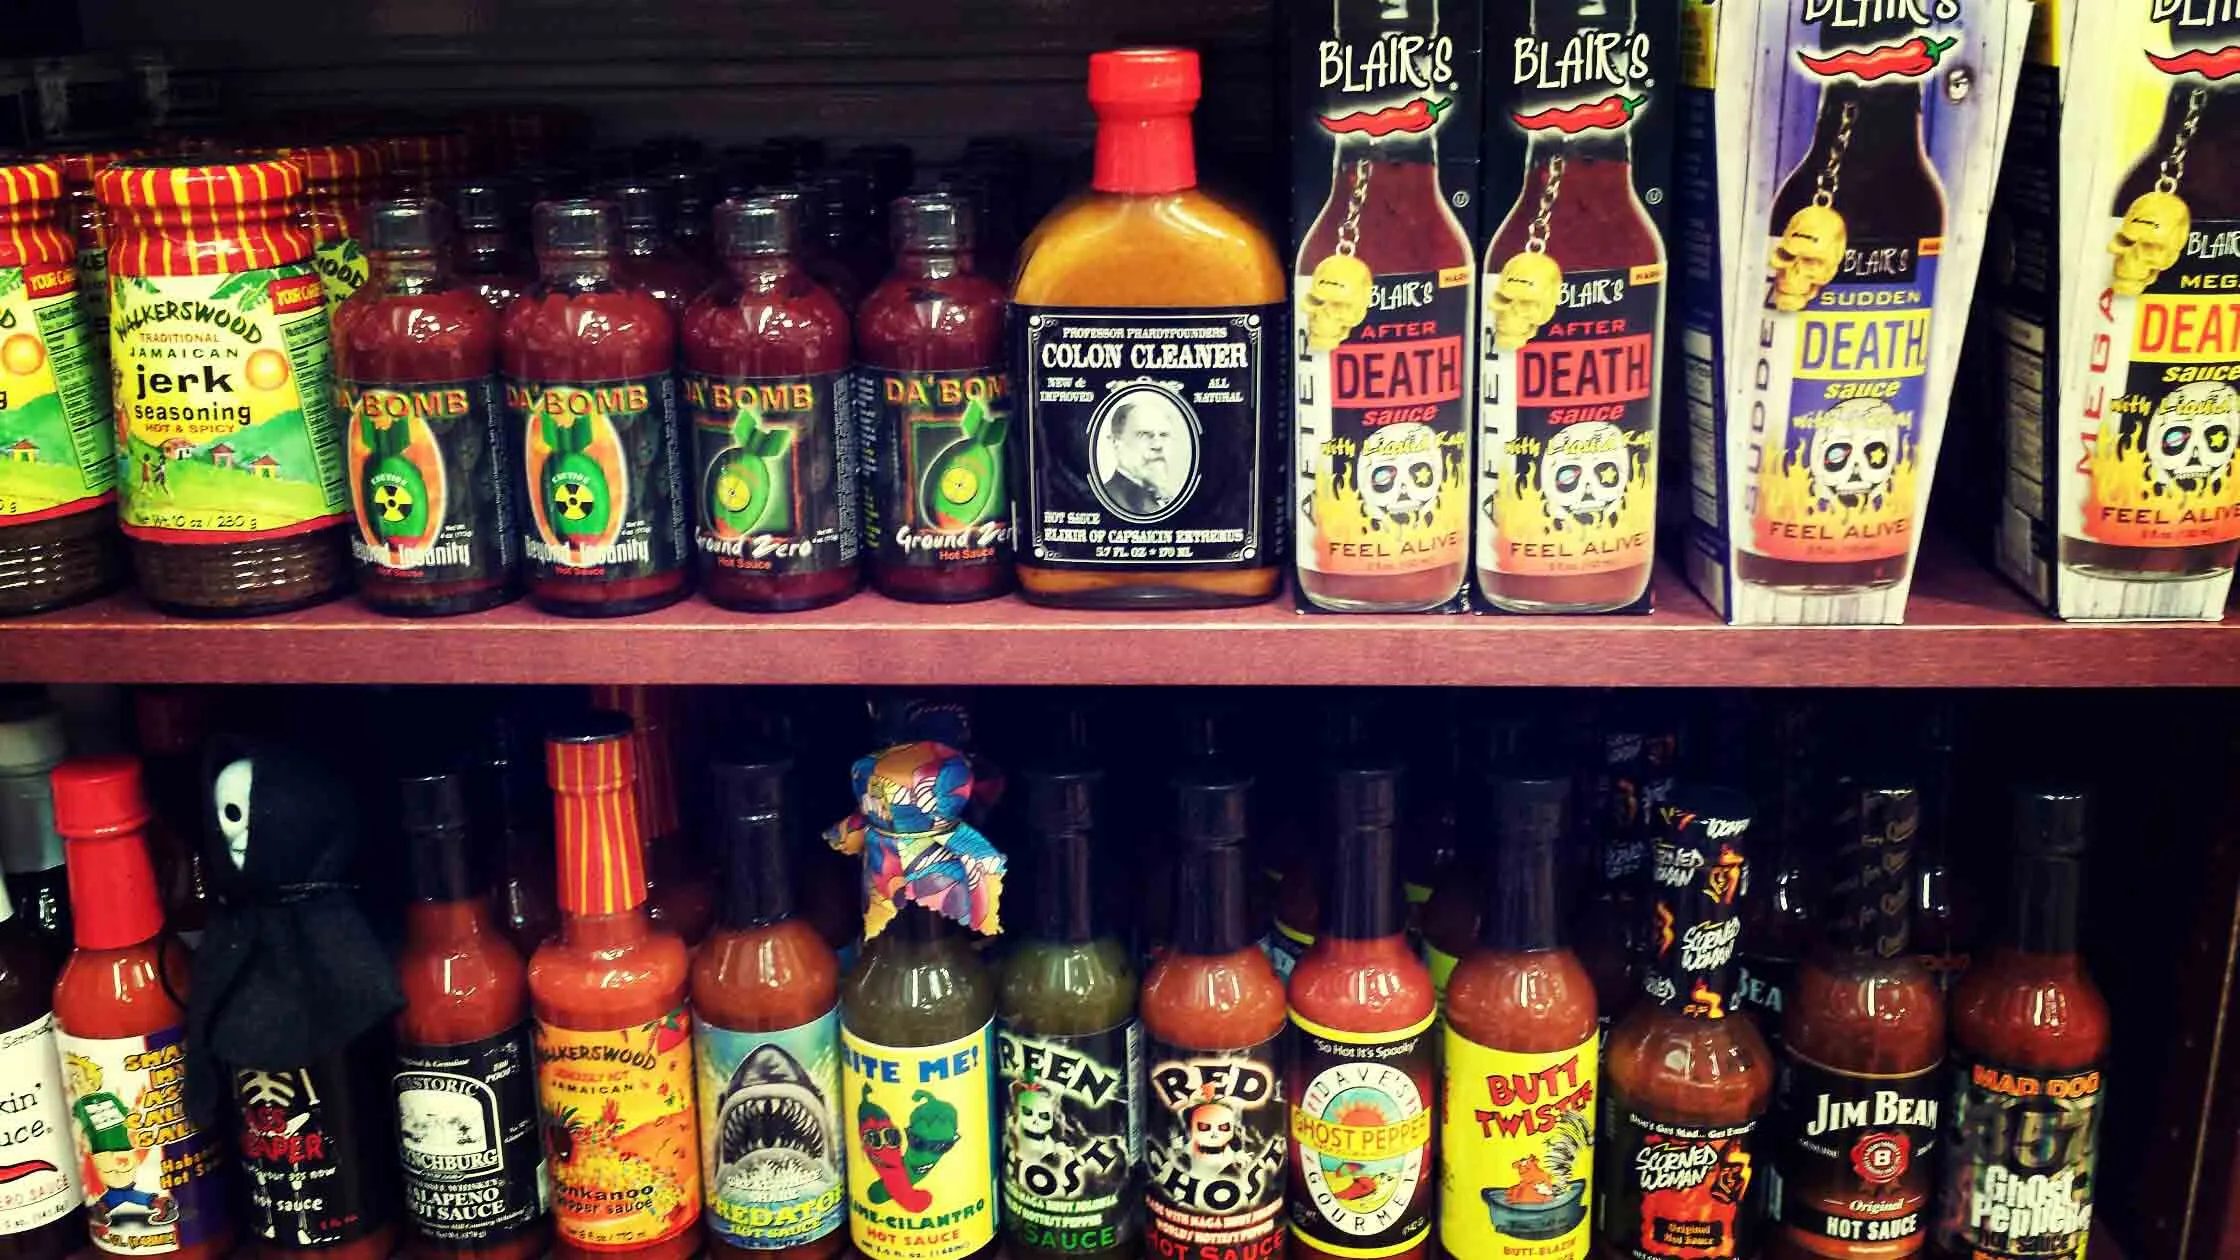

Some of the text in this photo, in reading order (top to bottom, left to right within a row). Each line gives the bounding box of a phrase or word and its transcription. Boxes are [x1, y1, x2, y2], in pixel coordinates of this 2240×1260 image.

[1319, 34, 1453, 93] BLAIR'S
[1513, 32, 1651, 91] BLAIR'S
[2187, 230, 2240, 259] BLAIR
[1843, 248, 1909, 277] BLAIR'S
[1558, 278, 1625, 309] BLAIR'S
[2181, 274, 2240, 290] MEG
[1368, 279, 1434, 311] BLAIR'S
[1820, 290, 1922, 306] SUDDEN
[139, 332, 220, 344] TRADITIONAL
[1062, 327, 1125, 339] PROFESSOR
[1360, 319, 1437, 339] AFTER
[1547, 318, 1627, 338] AFTER
[2139, 303, 2240, 354] DEAT
[130, 346, 239, 359] JAMAICAN
[1800, 315, 1927, 371] DEATH
[1041, 343, 1248, 369] COLON CLEANER
[1335, 345, 1458, 401] DEATH
[1521, 341, 1648, 399] DEATH
[2075, 286, 2115, 477] MEGA
[2162, 363, 2240, 384] sauce
[136, 364, 234, 400] jerk
[886, 373, 1007, 406] DA'BOM
[1047, 377, 1087, 388] NEW &
[1207, 377, 1229, 389] ALL
[1823, 380, 1903, 400] sauce
[337, 385, 469, 417] A'BOMB
[1040, 391, 1095, 402] IMPROVED
[1193, 391, 1244, 403] NATURAL
[135, 402, 251, 426] seasoning
[1361, 404, 1440, 427] sauce
[1547, 403, 1625, 425] sauce
[145, 423, 170, 434] HOT
[188, 424, 235, 434] SPICY
[1043, 511, 1100, 525] HOT SAUCE
[2101, 506, 2170, 525] FEEL
[895, 520, 1017, 556] Ground Zer
[1043, 528, 1087, 542] ELIXIR
[1089, 529, 1106, 543] OF
[1769, 520, 1834, 540] FEEL
[751, 533, 812, 559] Zero
[1329, 542, 1391, 558] FEEL
[1511, 542, 1574, 558] FEEL
[1333, 1044, 1355, 1057] Hot
[919, 1045, 979, 1083] ME!
[999, 1035, 1116, 1104] REEN
[400, 1078, 479, 1097] STORIC
[1152, 1064, 1269, 1105] RED
[1314, 1067, 1410, 1098] DAVE'S
[1486, 1054, 1579, 1107] BUTT
[1973, 1064, 2041, 1097] MAD
[1807, 1093, 1870, 1137] JIM
[404, 1148, 499, 1171] NCHBURG
[1007, 1139, 1117, 1197] OST
[1635, 1145, 1718, 1171] SCORNED
[1874, 1150, 1891, 1166] B
[1640, 1165, 1713, 1192] WOMAN
[1984, 1164, 2077, 1209] Ghost
[410, 1187, 500, 1207] LAPENO
[558, 1185, 654, 1201] nkanoo
[276, 1198, 323, 1212] sauce
[437, 1200, 506, 1221] SAUCE
[607, 1198, 653, 1215] sauce
[1849, 1197, 1905, 1215] Original
[867, 1226, 960, 1246] HOT SAUCE
[1022, 1225, 1117, 1250] SAUCE
[1826, 1213, 1917, 1241] HOT SAUCE
